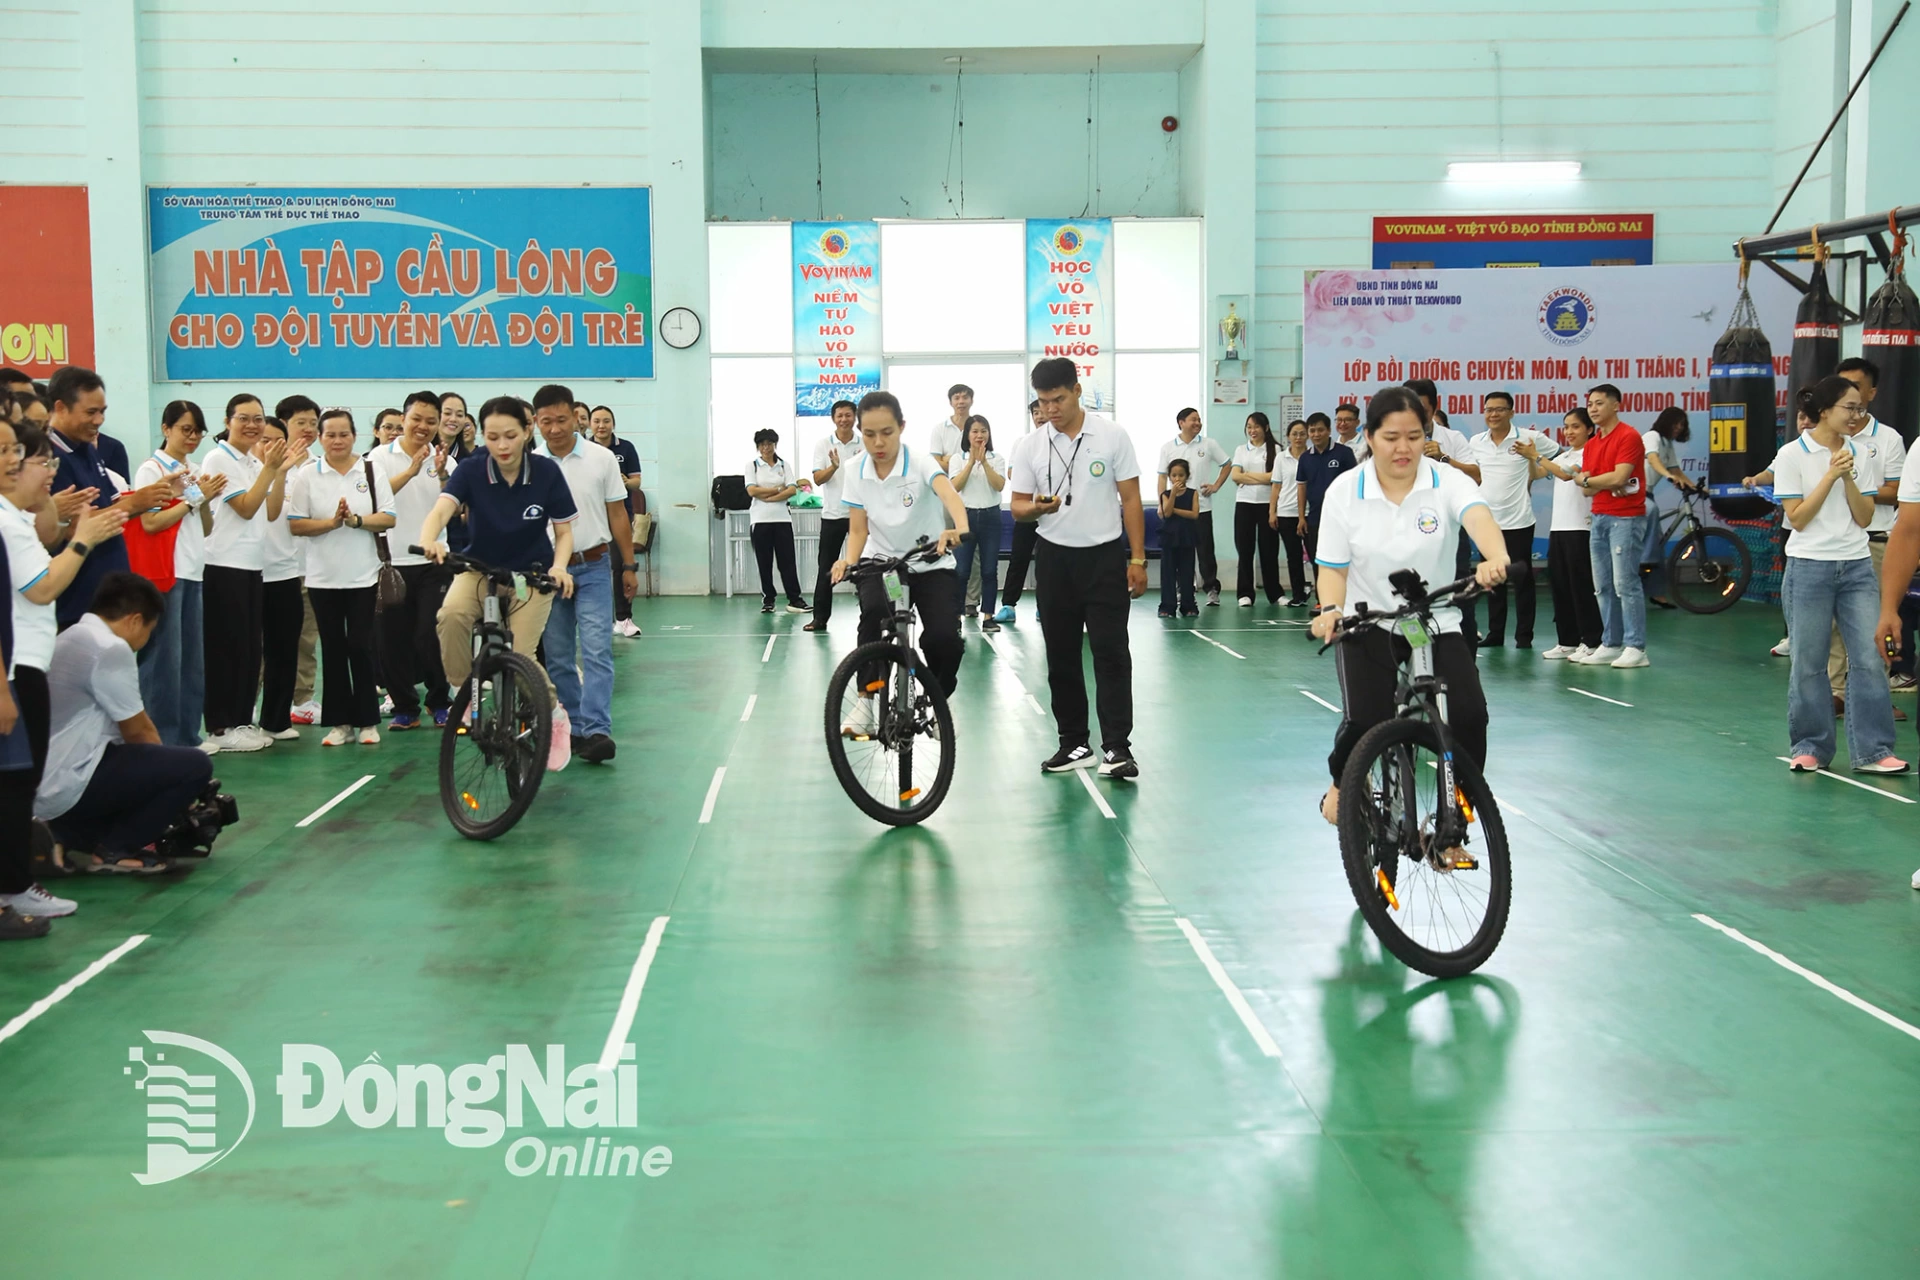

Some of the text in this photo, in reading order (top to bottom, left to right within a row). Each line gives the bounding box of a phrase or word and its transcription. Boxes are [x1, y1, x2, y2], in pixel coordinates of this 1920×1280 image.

[181, 196, 204, 206] VĂN
[207, 194, 230, 206] HÓA
[254, 197, 283, 206] THAO
[285, 197, 295, 206] &
[298, 197, 312, 206] DU
[316, 197, 339, 209] LỊCH
[376, 198, 395, 207] NAI
[200, 210, 236, 219] TRUNG
[239, 208, 262, 219] TÂM
[286, 210, 307, 221] DỤC
[332, 210, 360, 219] THAO
[1385, 223, 1446, 235] VOVINAM
[1456, 221, 1487, 237] VIỆT
[1489, 220, 1508, 234] VÕ
[1511, 223, 1540, 237] ĐẠO
[1543, 220, 1575, 233] TỈNH
[1578, 218, 1616, 233] ĐỒNG
[1620, 221, 1643, 232] NAI
[193, 232, 618, 309] NHÀ TẬP CẦU LÔNG
[799, 262, 873, 284] VOVINAM
[1050, 261, 1091, 277] HỌC
[1057, 278, 1084, 294] VÕ
[1356, 281, 1378, 290] UBND
[1380, 279, 1398, 290] TỈNH
[1424, 280, 1438, 290] NAI
[1333, 295, 1349, 306] LIÊN
[1414, 295, 1462, 306] TAEKWONDO
[1540, 287, 1594, 312] TAEKWONDO
[824, 307, 848, 321] TỰ
[1048, 300, 1094, 318] VIỆT
[168, 301, 645, 355] CHO ĐỘI TUYỂN VÀ ĐỘI TRẺ
[819, 323, 855, 336] HÀO
[1051, 321, 1091, 336] YÊU
[0, 322, 69, 365] ƠN
[825, 339, 848, 352] VÕ
[1044, 341, 1099, 357] NƯỚC
[818, 355, 856, 370] VIỆT
[1344, 359, 1371, 382] LỚP
[1377, 355, 1403, 382] BỒI
[1409, 358, 1460, 381] DƯỠNG
[1467, 357, 1525, 380] CHUYÊN
[1578, 356, 1598, 379] ÔN
[1604, 358, 1630, 379] THI
[1636, 355, 1685, 378] THĂNG
[819, 374, 856, 384] NAM
[1448, 394, 1473, 414] ĐAI
[1537, 387, 1578, 414] ĐẲNG
[1584, 392, 1675, 413] TWONDO
